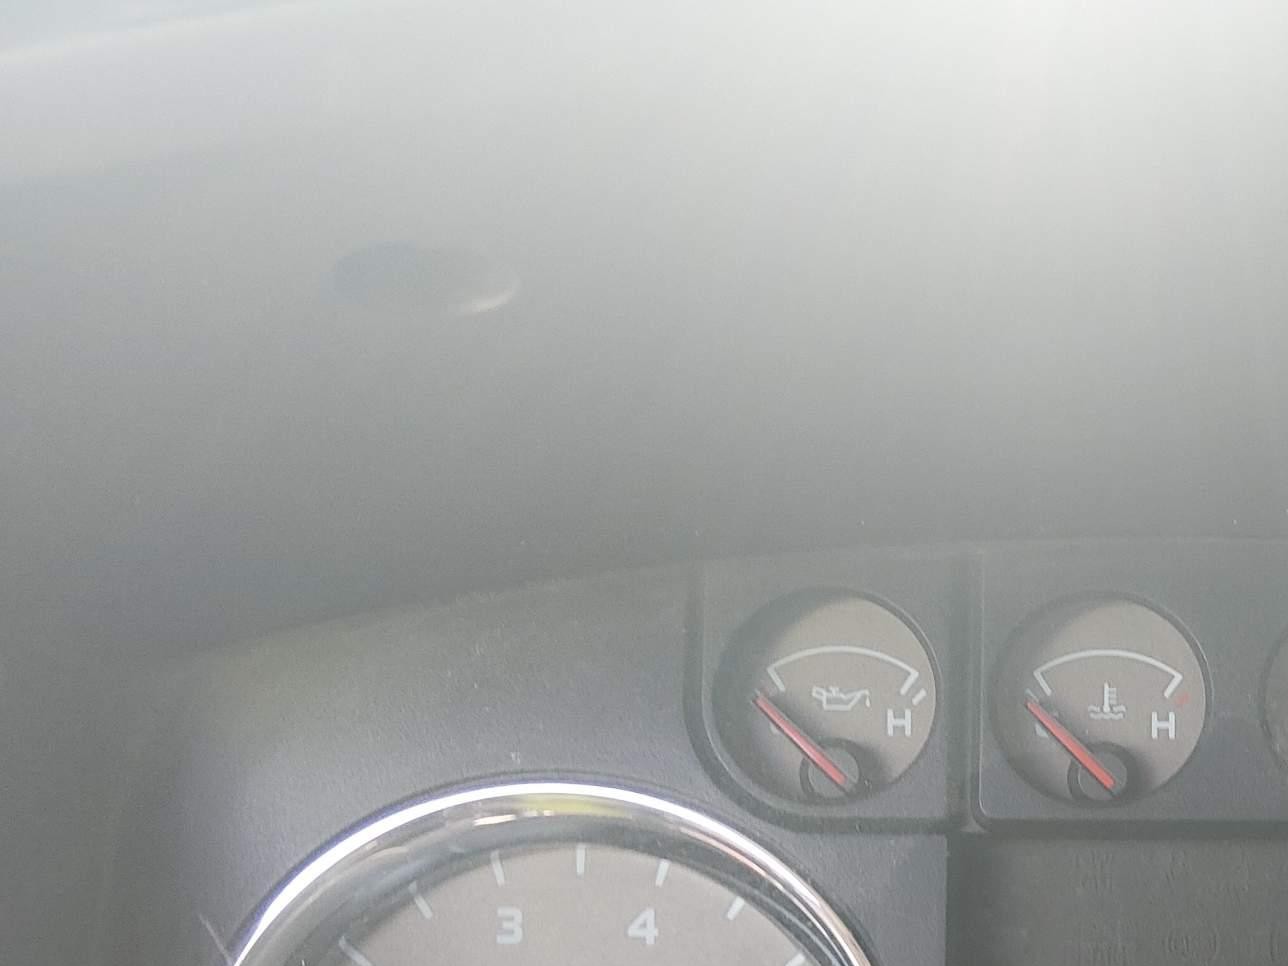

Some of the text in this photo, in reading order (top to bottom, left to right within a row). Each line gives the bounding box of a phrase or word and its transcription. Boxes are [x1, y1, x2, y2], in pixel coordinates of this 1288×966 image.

[887, 709, 912, 737] H
[1151, 712, 1175, 739] H
[496, 908, 523, 944] 3
[627, 910, 659, 945] 4
